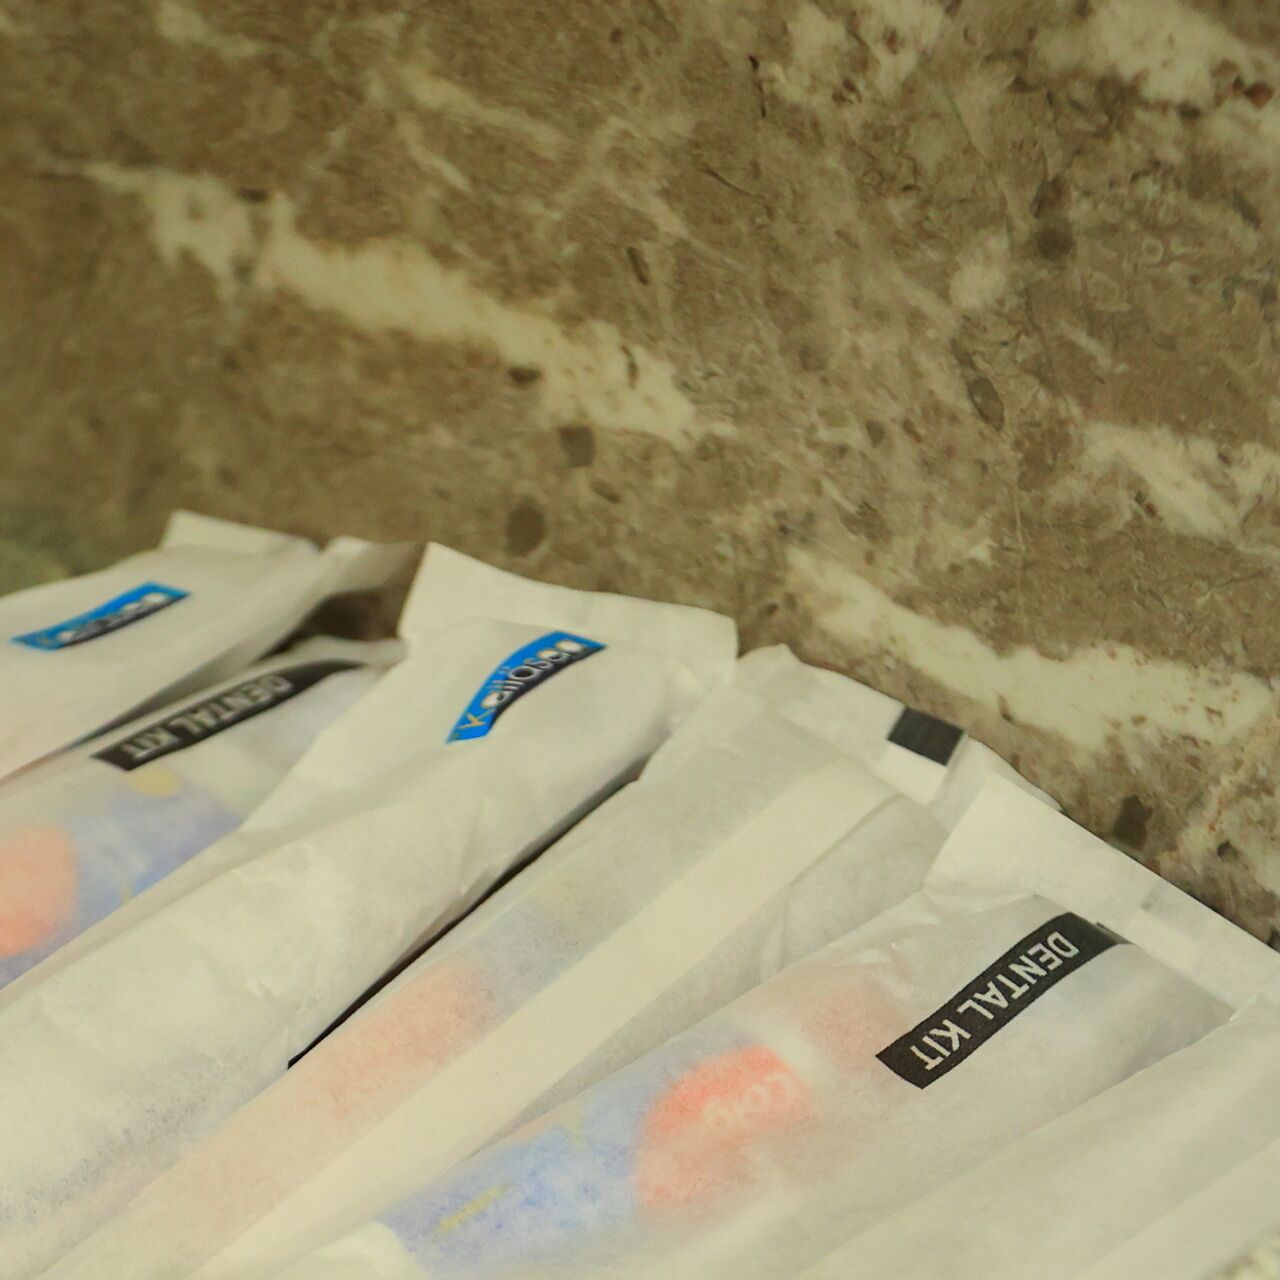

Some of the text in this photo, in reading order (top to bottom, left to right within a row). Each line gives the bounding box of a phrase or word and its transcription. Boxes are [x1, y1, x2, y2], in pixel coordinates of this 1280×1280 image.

[122, 674, 294, 759] DENTAL KIT
[909, 931, 1080, 1072] DENTAL KIT
